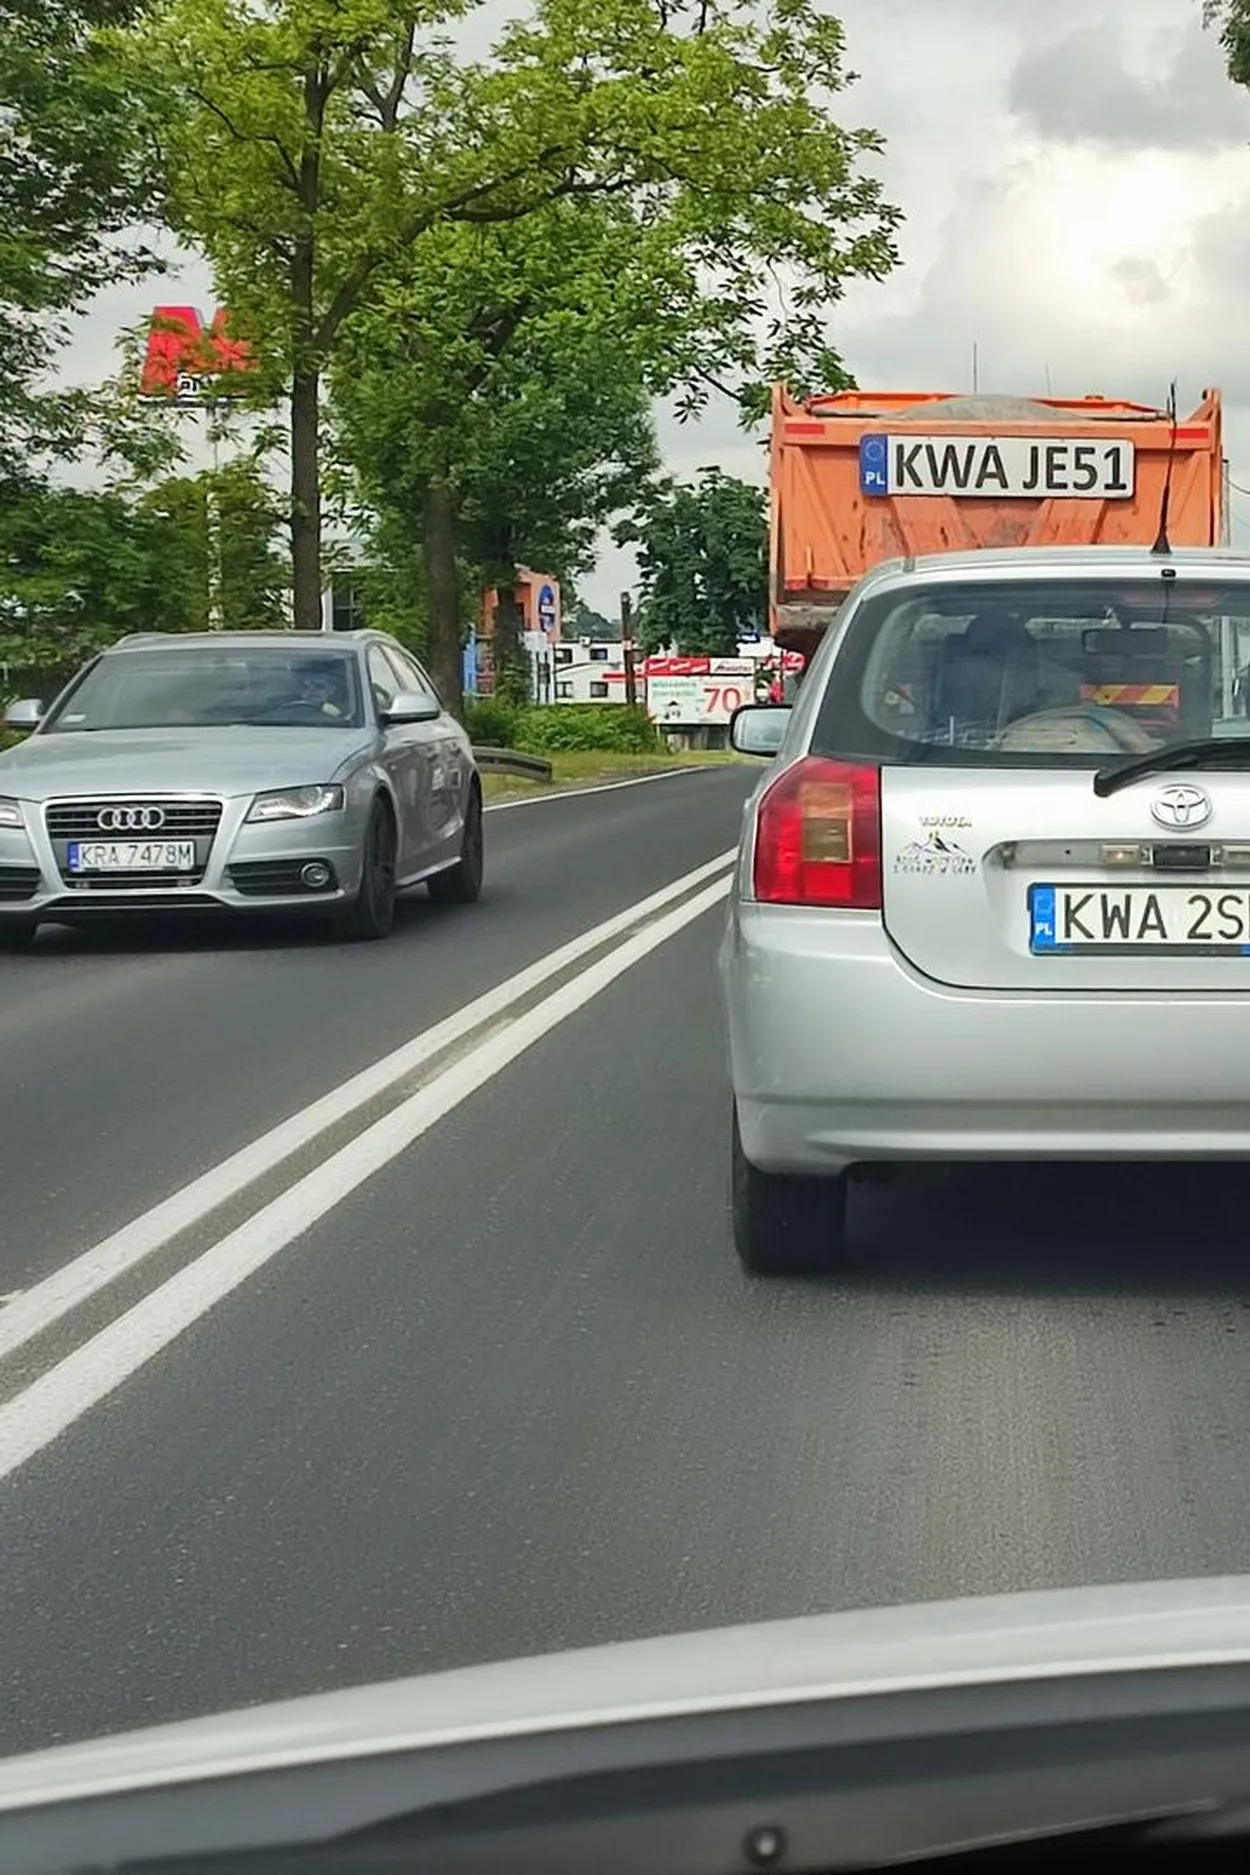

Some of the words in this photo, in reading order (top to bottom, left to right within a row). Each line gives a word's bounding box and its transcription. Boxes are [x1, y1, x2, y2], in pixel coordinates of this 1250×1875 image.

[865, 471, 886, 485] PL
[895, 443, 1009, 489] KWA
[1022, 446, 1128, 491] JE51
[703, 687, 741, 713] 70
[81, 845, 120, 865] KRA
[127, 844, 192, 865] 7478M
[1063, 894, 1168, 939] KWA
[1035, 923, 1053, 935] PL
